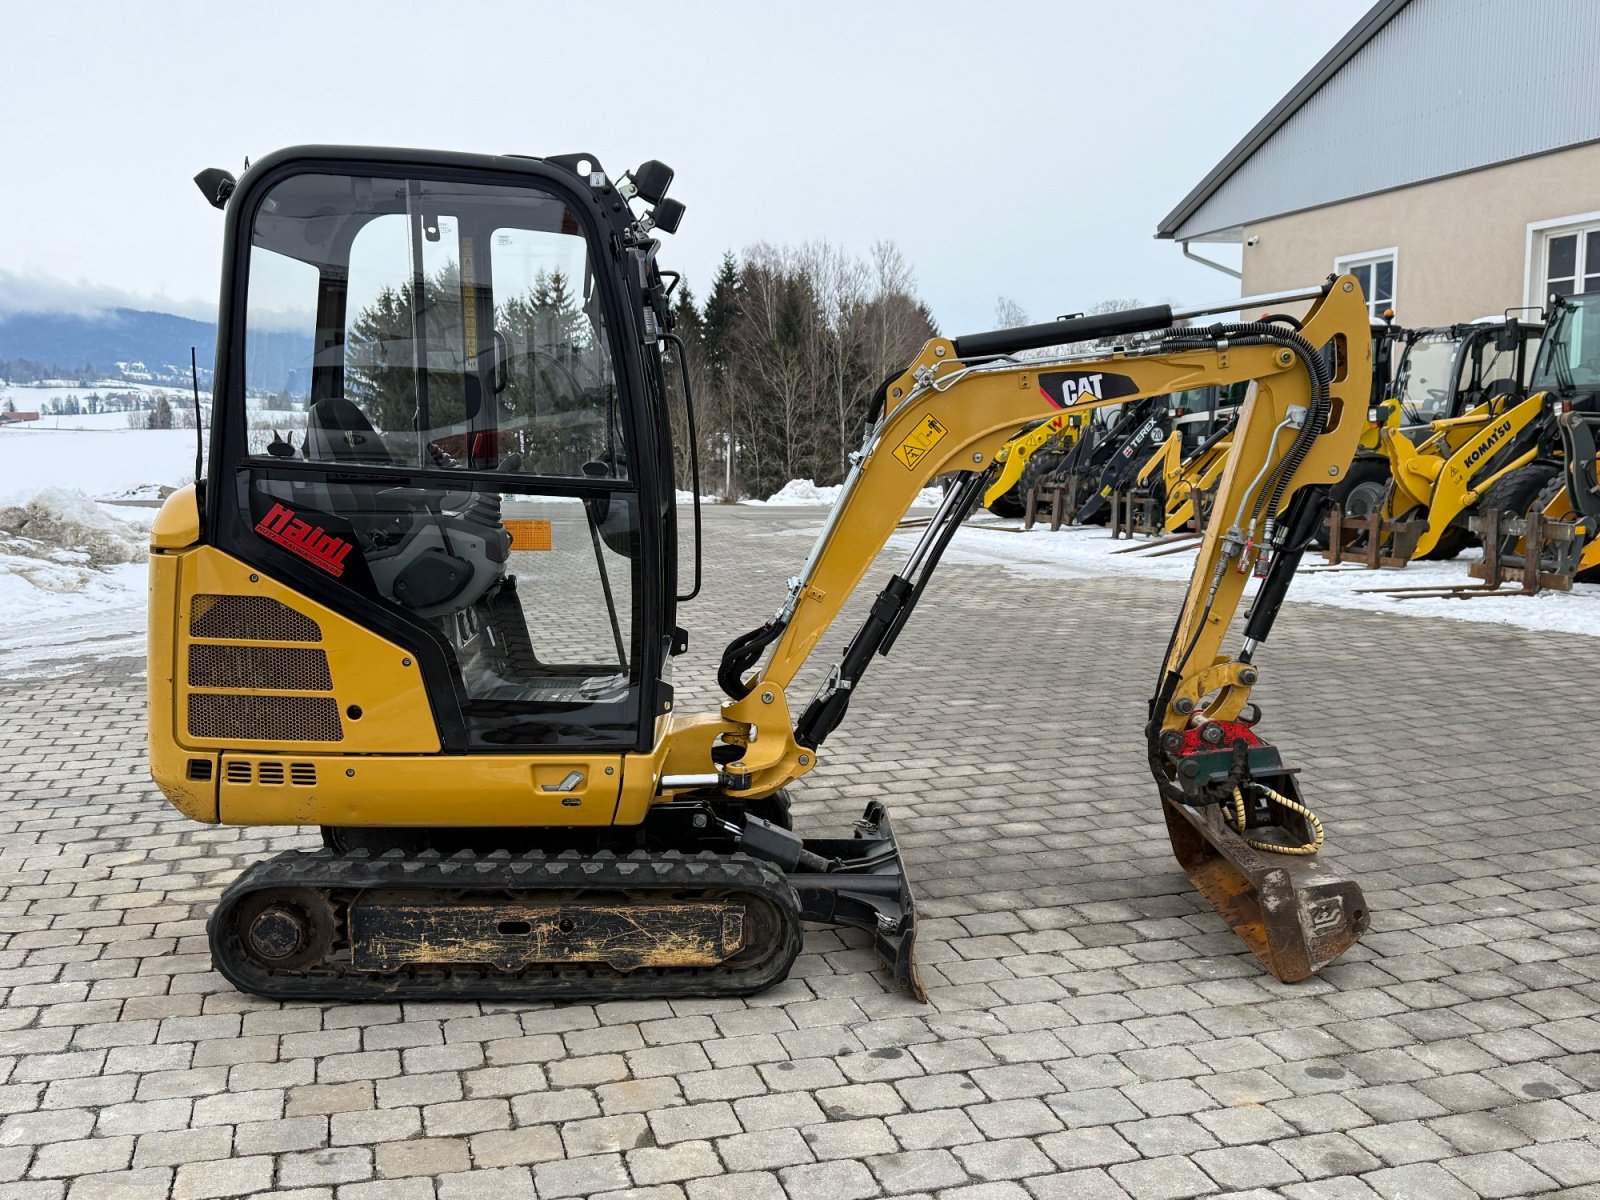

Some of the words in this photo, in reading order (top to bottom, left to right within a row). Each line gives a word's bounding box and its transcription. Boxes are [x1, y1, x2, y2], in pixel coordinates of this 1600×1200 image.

[1062, 374, 1103, 406] CAT
[1130, 417, 1157, 447] TEREX
[1464, 420, 1511, 468] KOMATSU
[260, 503, 353, 570] Haidl
